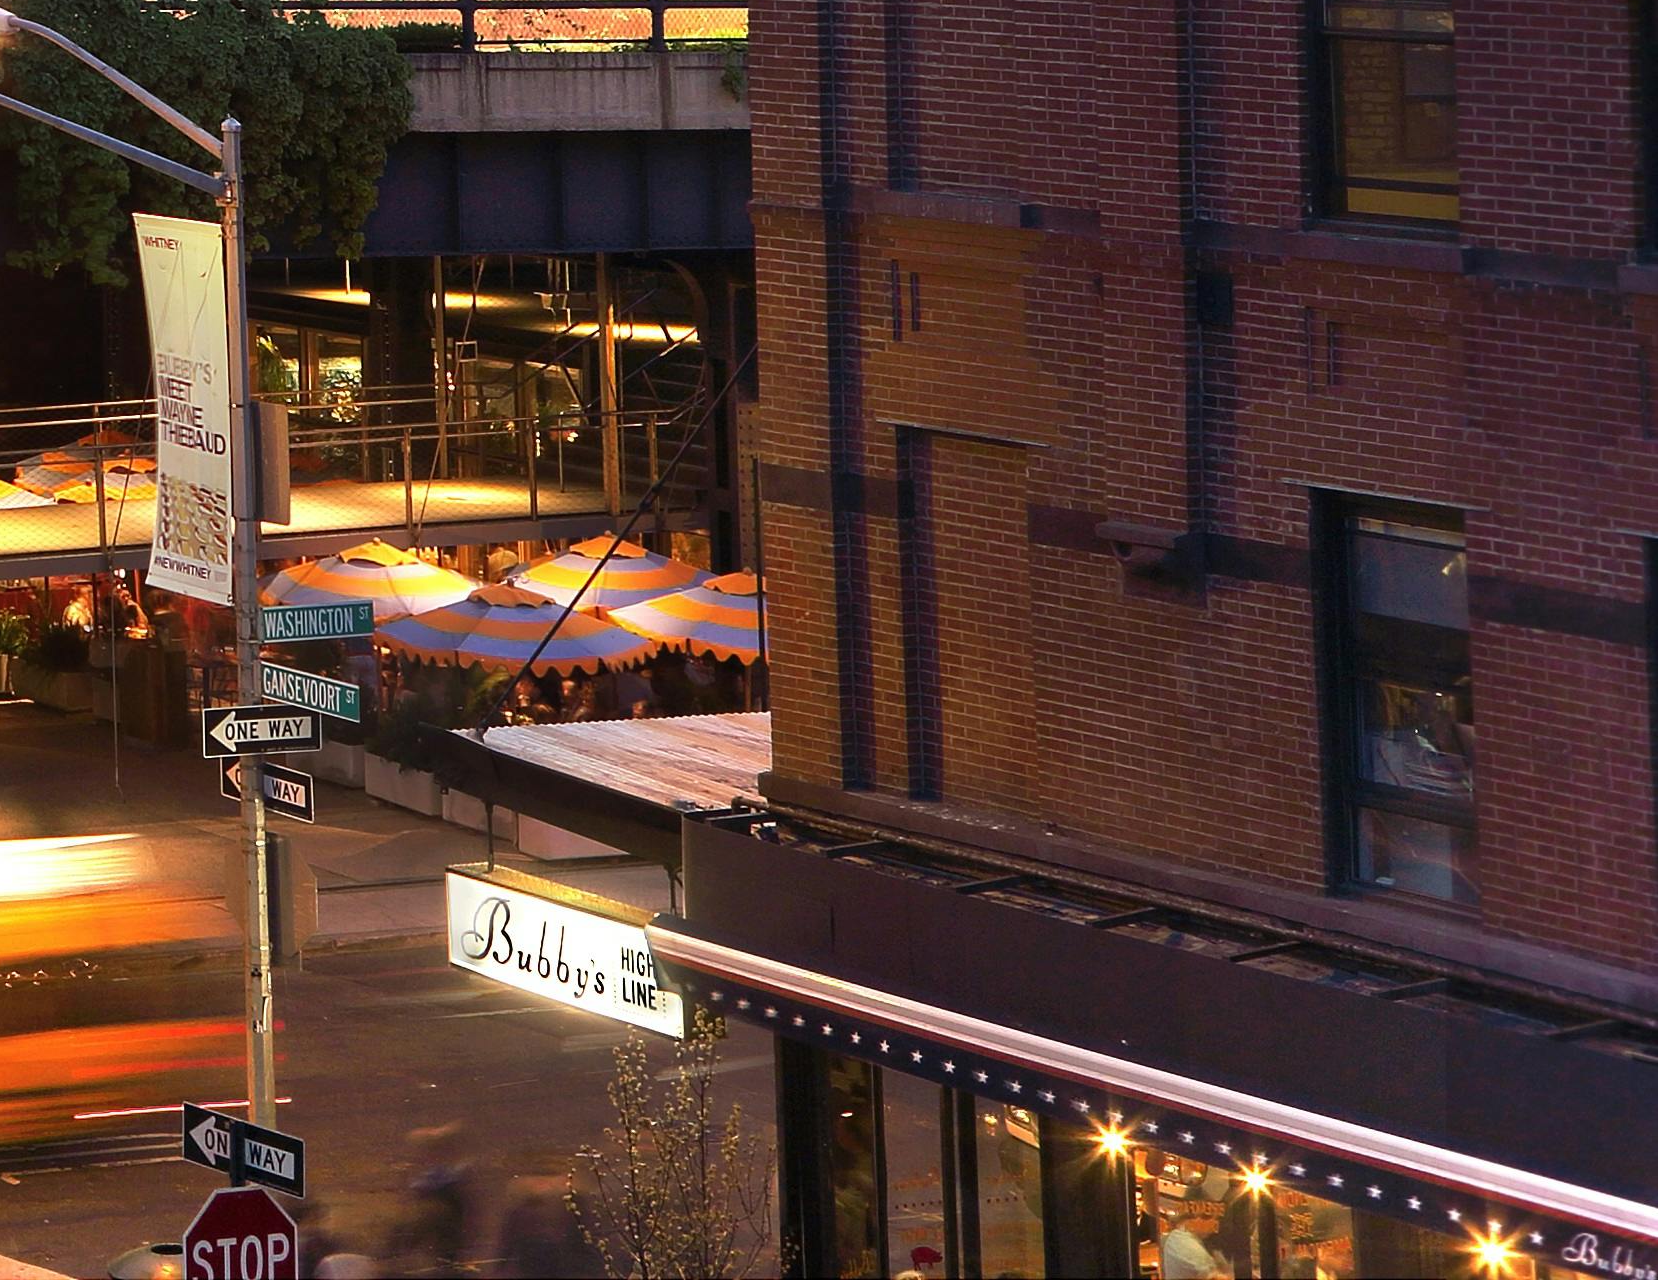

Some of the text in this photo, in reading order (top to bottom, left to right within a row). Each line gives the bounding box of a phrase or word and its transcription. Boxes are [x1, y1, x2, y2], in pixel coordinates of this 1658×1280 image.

[143, 236, 179, 250] WHITNEY
[158, 375, 192, 402] MEET
[159, 398, 203, 428] WAYNE
[155, 555, 211, 579] #NEWWHITNEY
[264, 606, 370, 638] WASHINGTON ST
[264, 667, 356, 713] GANSEVOORT ST
[225, 719, 304, 740] ONE WAY
[271, 778, 300, 804] WAY
[461, 896, 605, 999] Bubby's
[621, 946, 655, 979] HIGH
[622, 977, 658, 1011] LINE
[204, 1128, 287, 1175] ON WAY
[192, 1232, 290, 1280] STOP
